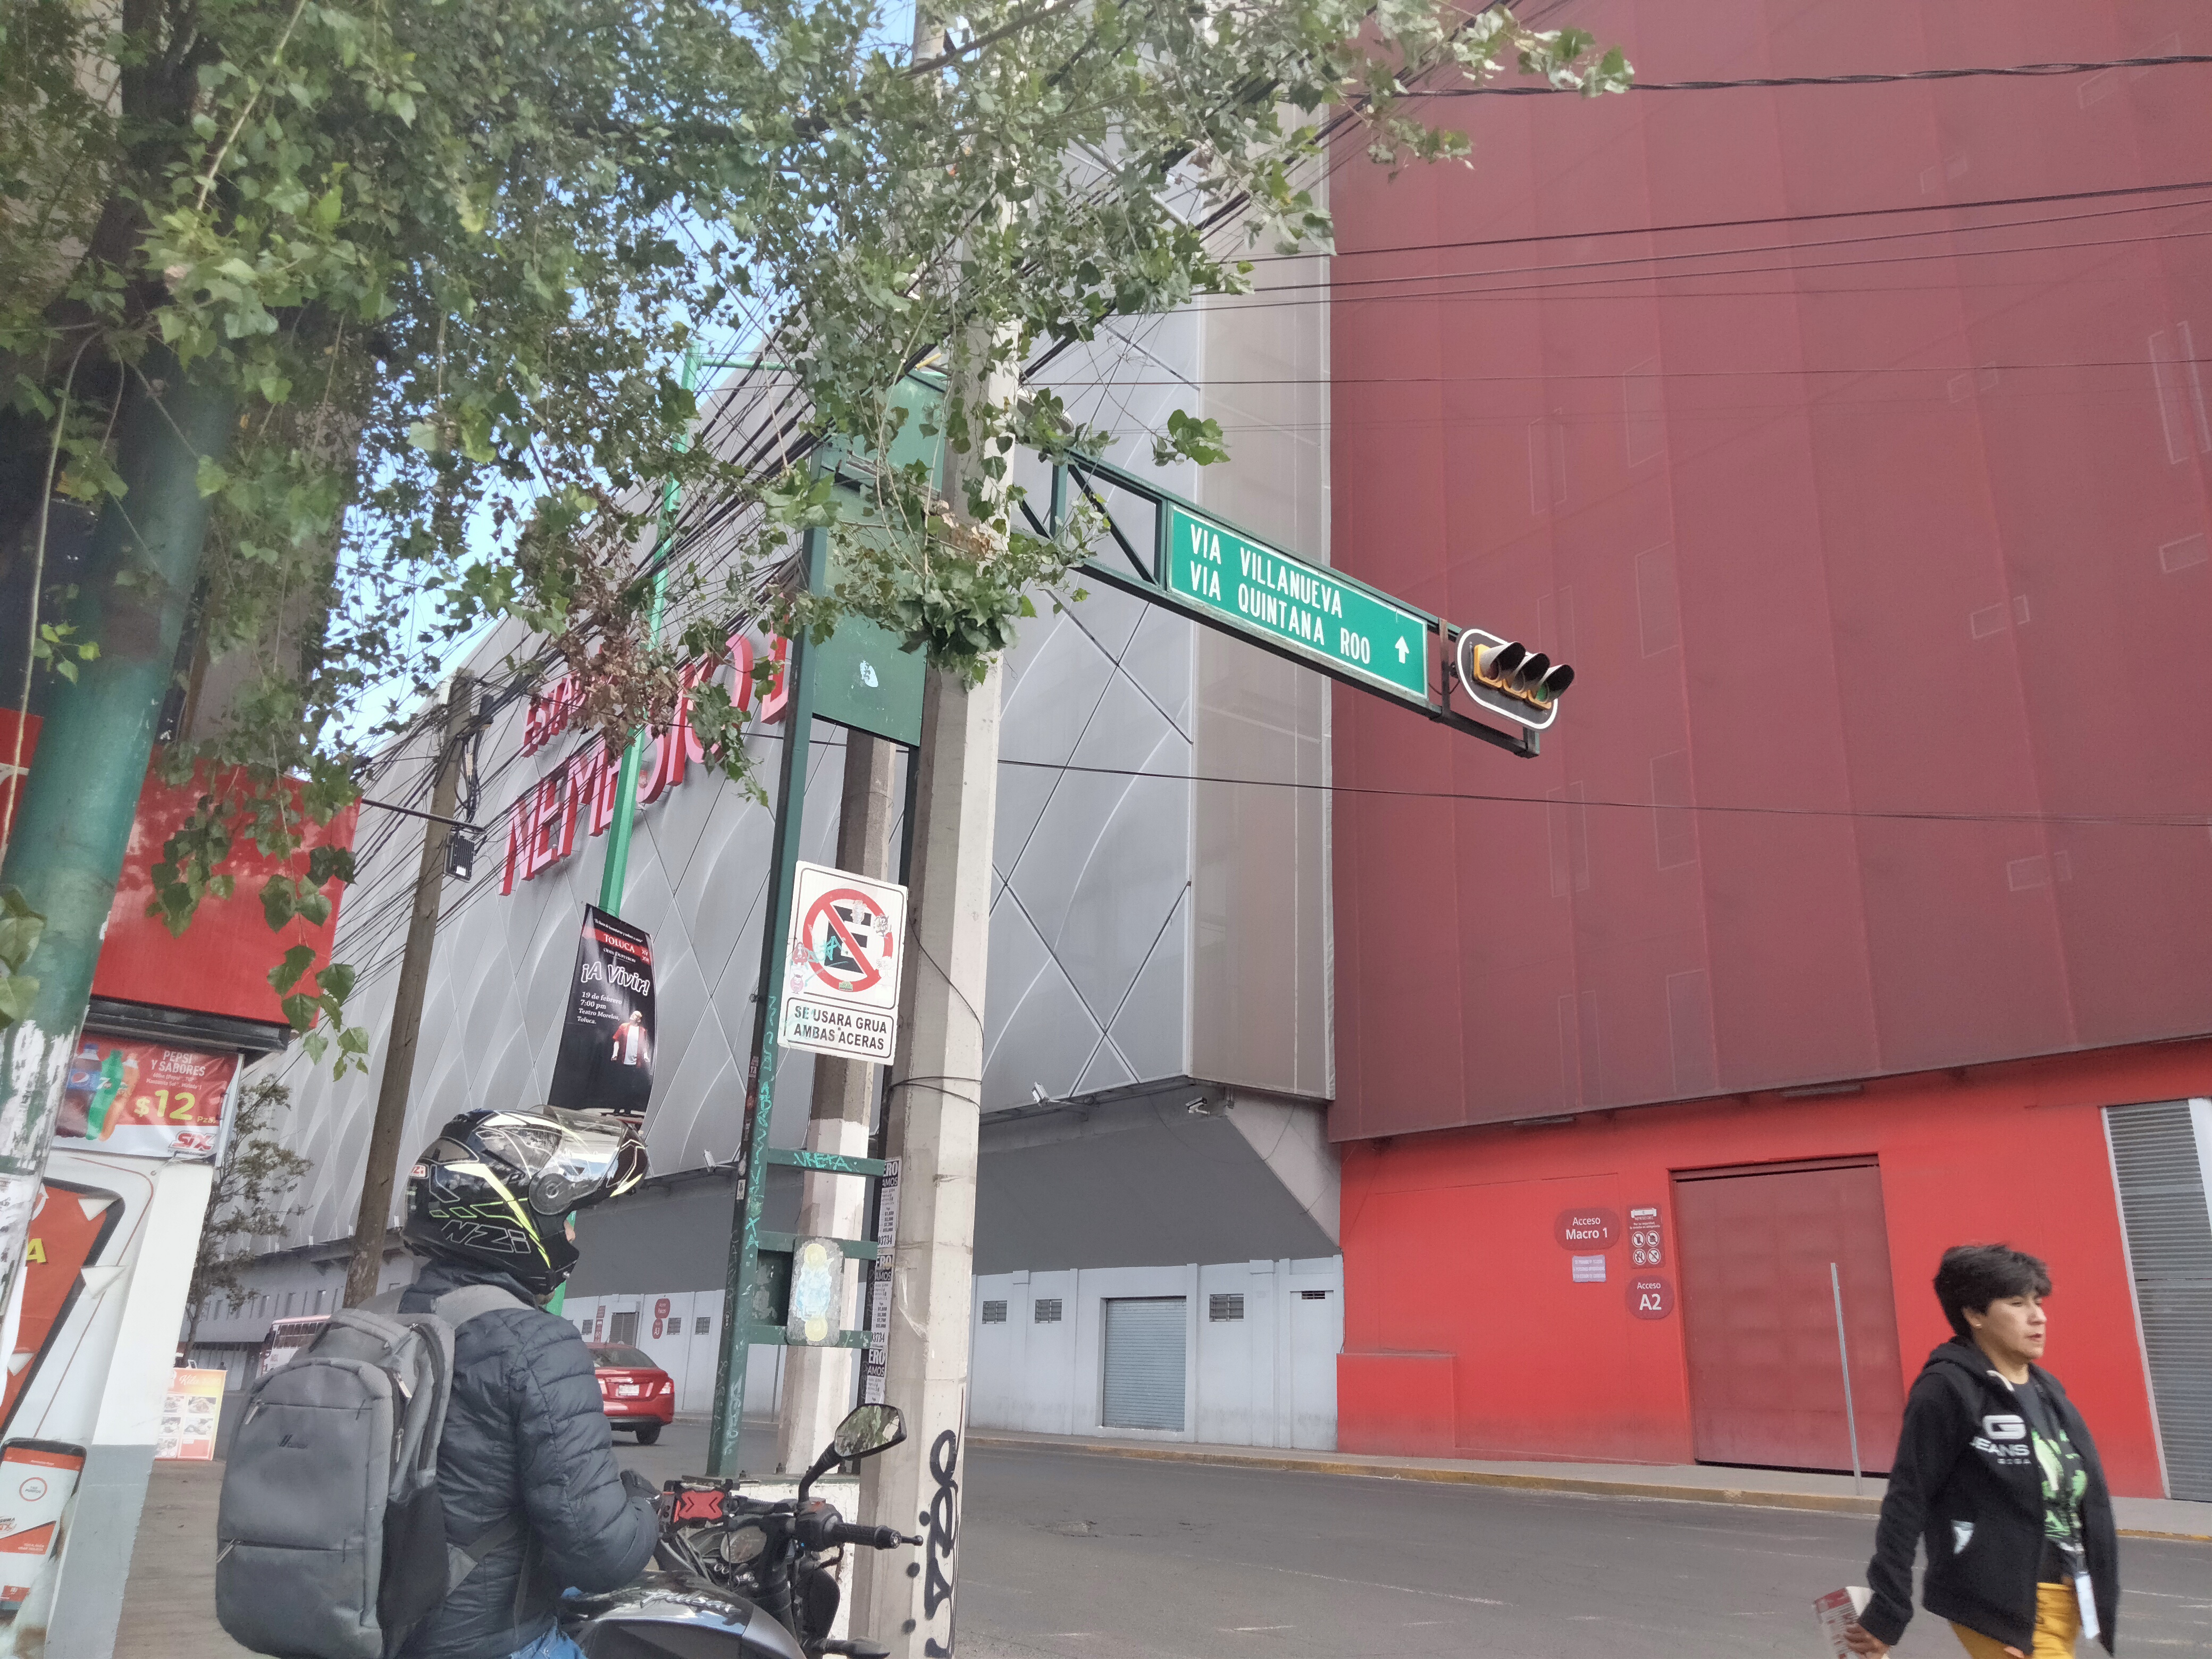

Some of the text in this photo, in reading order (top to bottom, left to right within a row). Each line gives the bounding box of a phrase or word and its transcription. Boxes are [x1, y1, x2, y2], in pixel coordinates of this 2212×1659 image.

[1190, 523, 1343, 618] VIA VILLANUEVA
[1190, 560, 1371, 665] VIA QUINTANA ROO
[603, 933, 635, 953] TOLUCA
[607, 964, 650, 996] Vivir!
[600, 994, 622, 1004] febrero
[578, 1008, 597, 1016] Teatro
[794, 1005, 887, 1034] SE USARA GRUA
[793, 1023, 884, 1050] AMBAS ACERAS
[163, 1050, 194, 1063] PEPSI
[151, 1059, 206, 1077] Y SABORES
[1572, 1217, 1601, 1226] Acceso
[1565, 1227, 1608, 1241] Macro 1
[1639, 1293, 1662, 1311] A2
